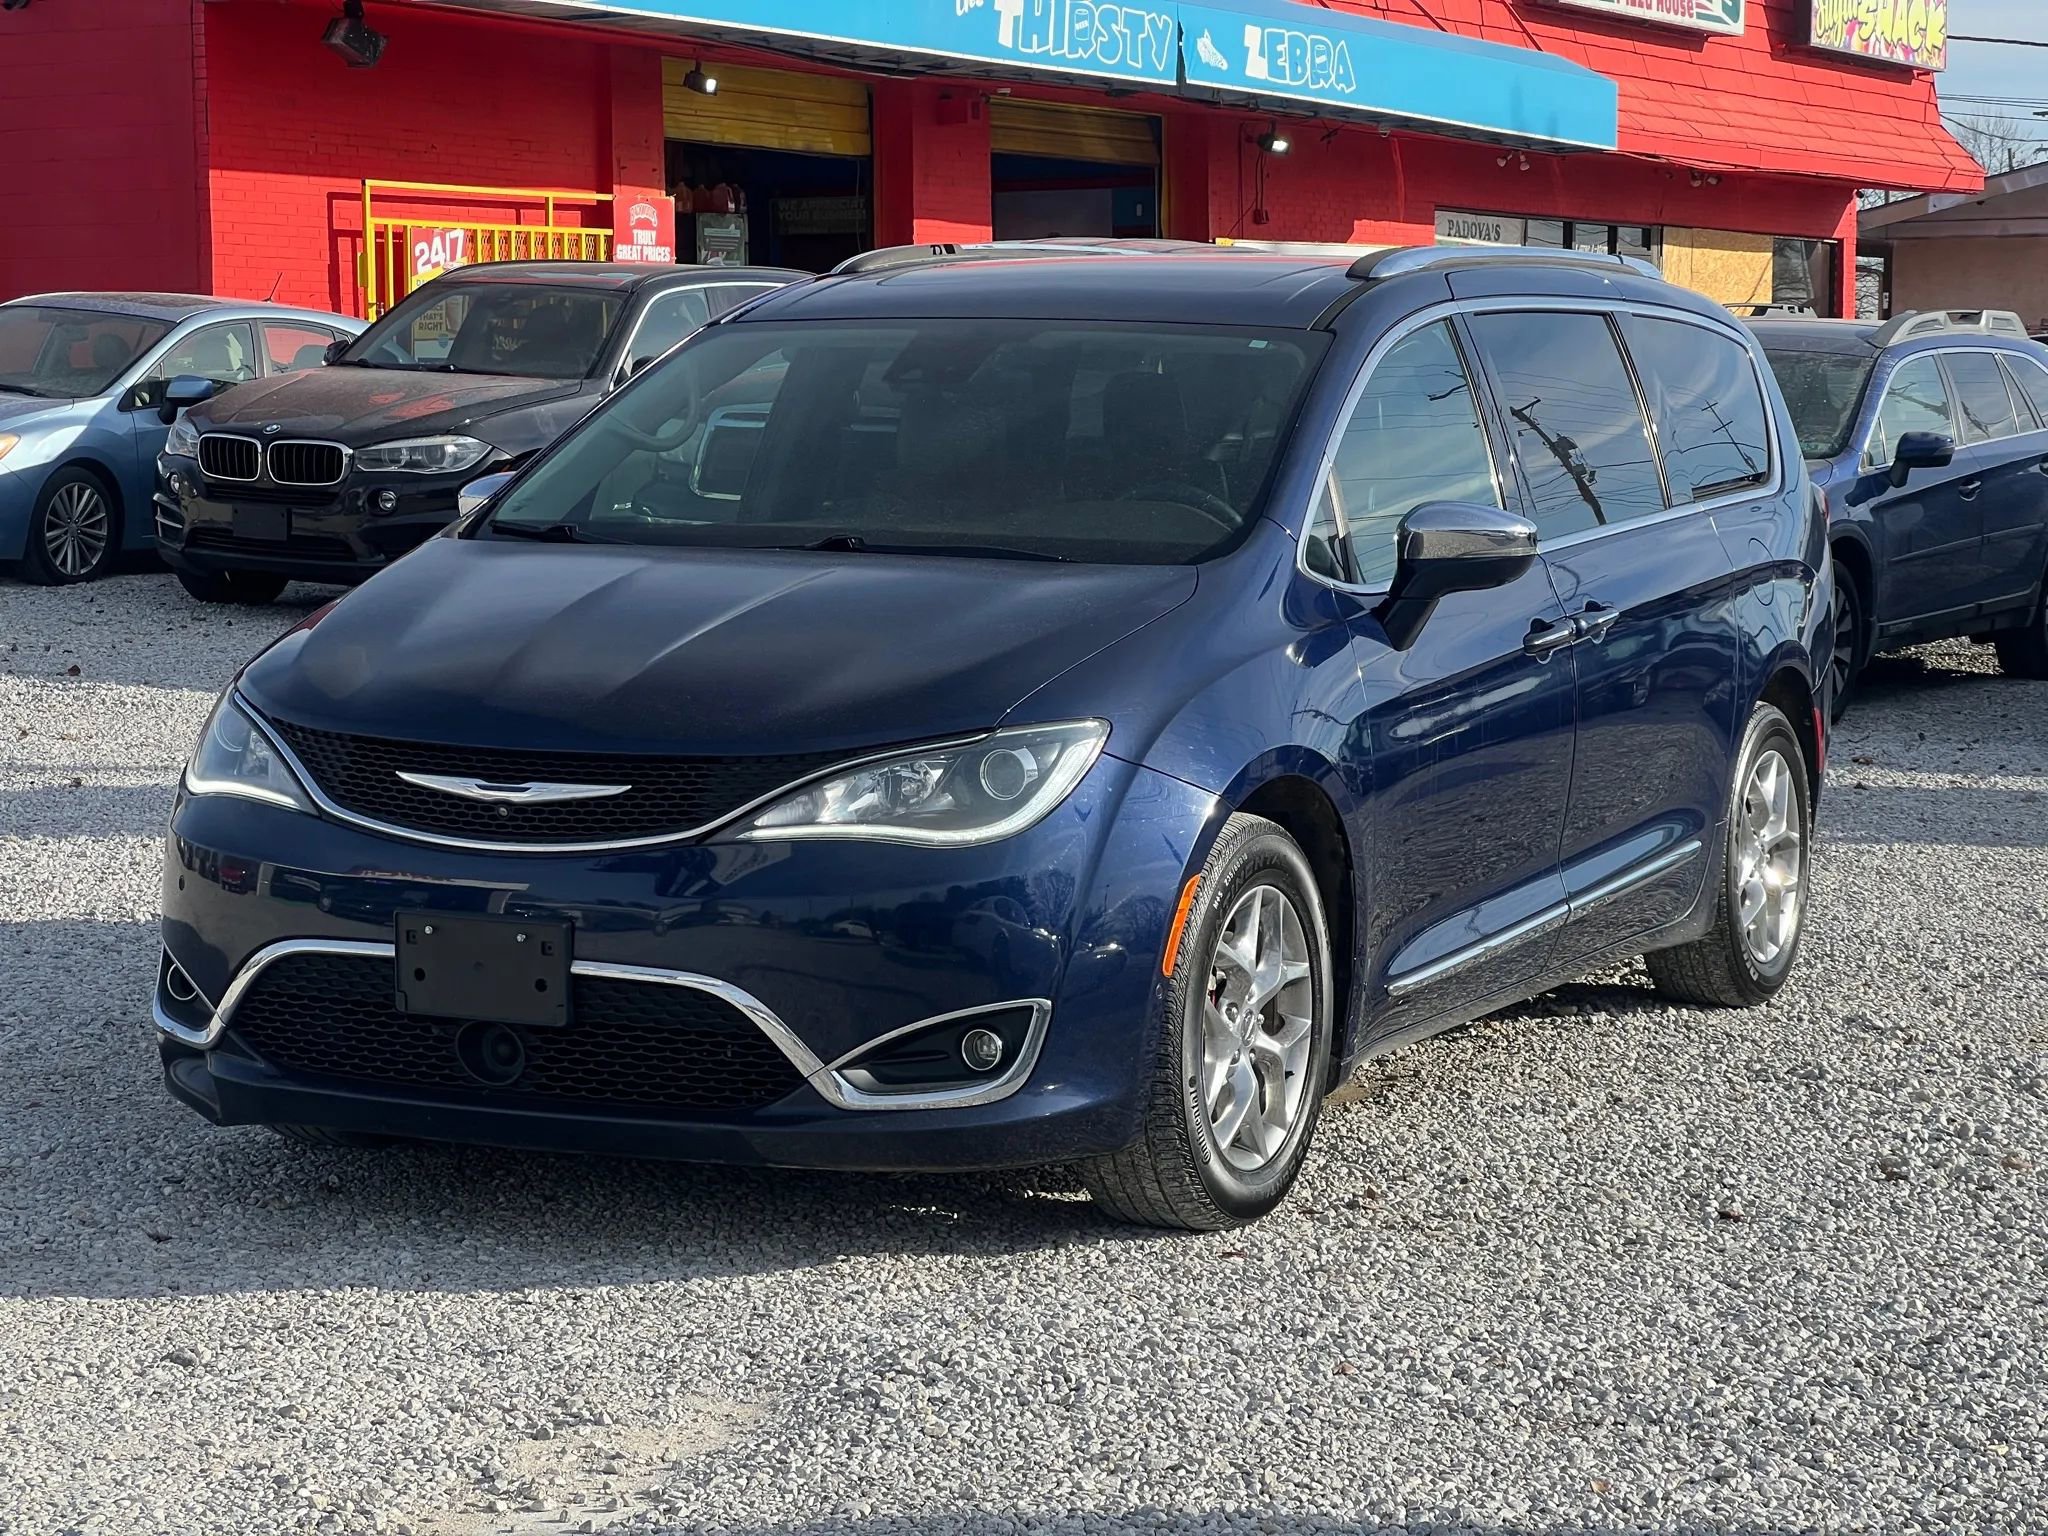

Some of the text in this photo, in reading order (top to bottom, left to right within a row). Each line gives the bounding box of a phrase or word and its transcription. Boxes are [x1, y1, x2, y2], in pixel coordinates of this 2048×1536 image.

[994, 0, 1173, 72] THIRSTY
[1244, 24, 1357, 94] ZEBRA
[632, 229, 657, 245] TRULY
[1447, 218, 1501, 242] PADOVA'S
[616, 244, 671, 263] GREAT PRICES
